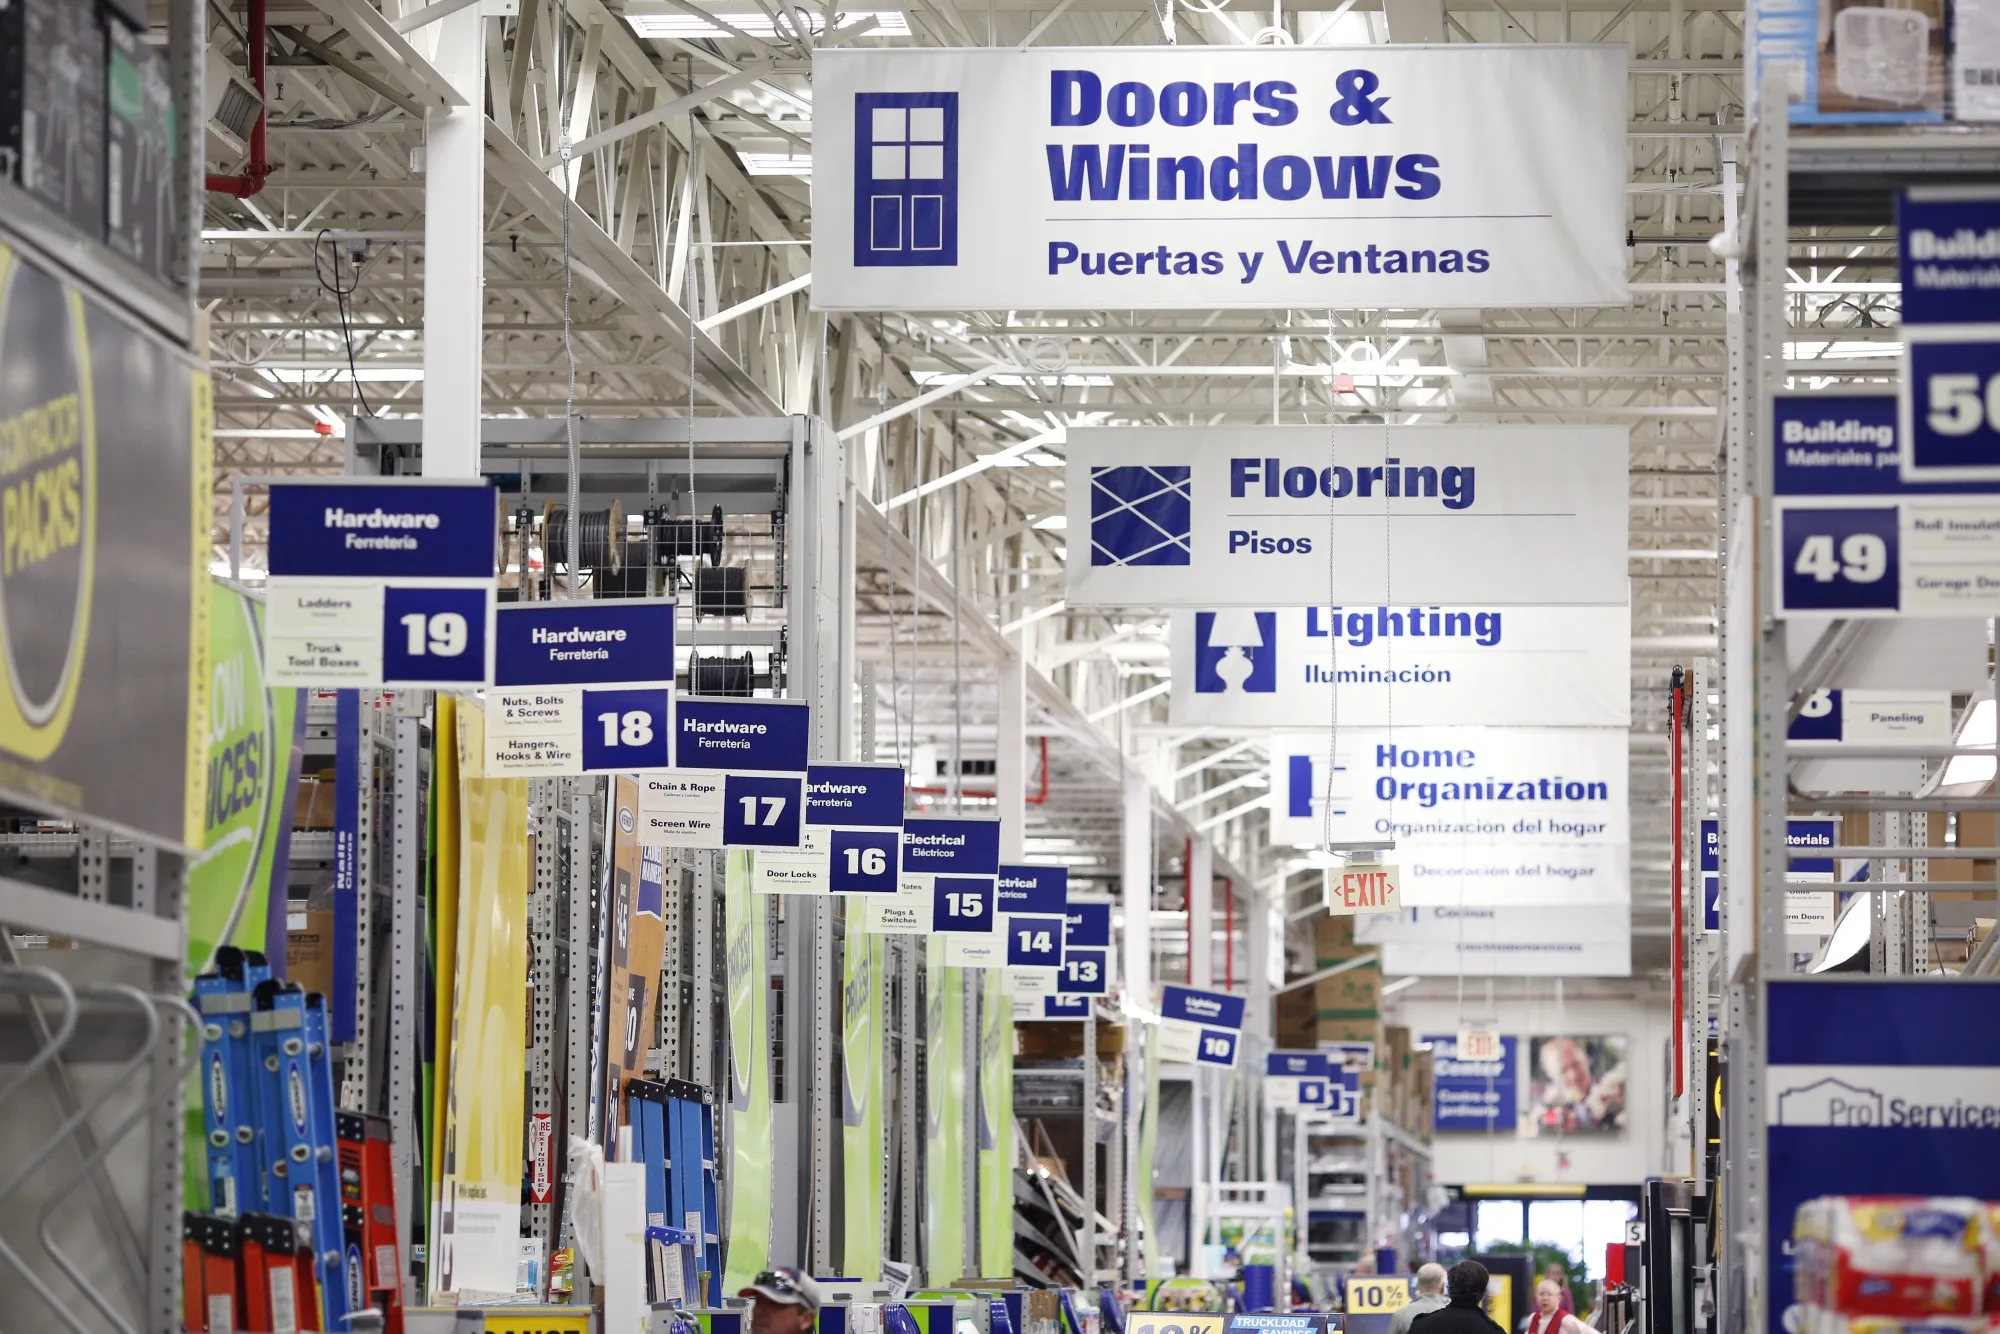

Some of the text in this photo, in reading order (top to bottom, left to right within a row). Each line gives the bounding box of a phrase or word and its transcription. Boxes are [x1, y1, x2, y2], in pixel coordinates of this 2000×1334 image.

[1050, 69, 1393, 127] Doors &
[1046, 143, 1441, 201] Windows
[1048, 240, 1490, 284] Puertas y Ventanas
[1926, 372, 2000, 436] 5
[1783, 420, 1893, 448] Building
[1786, 448, 1872, 466] Materiales
[1230, 458, 1475, 510] Flooring
[3, 456, 80, 578] PACKS
[325, 508, 440, 529] Hardware
[1229, 530, 1312, 554] Pisos
[1795, 534, 1886, 583] 49
[298, 599, 351, 608] Ladders
[400, 612, 468, 657] 19
[532, 627, 627, 644] Hardware
[1307, 607, 1502, 647] Lighting
[306, 643, 341, 653] Truck
[550, 647, 609, 661] Ferretería
[288, 657, 359, 667] Tool Boxes
[1304, 664, 1452, 684] Iluminación
[212, 651, 246, 742] OW
[502, 696, 564, 706] Nuts, Bolts
[506, 708, 560, 717] & Screws
[1870, 713, 1924, 724] Paneling
[598, 711, 653, 747] 18
[683, 718, 767, 734] Hardware
[508, 740, 559, 750] Hangers,
[698, 738, 751, 749] Ferretería
[496, 751, 571, 761] Hooks & Wire
[1376, 744, 1476, 768] Home
[649, 782, 716, 793] Chain & Rope
[807, 781, 867, 794] ardware
[1376, 776, 1608, 807] Organization
[739, 796, 786, 826] 17
[807, 797, 853, 807] Ferretería
[651, 819, 711, 829] Screen Wire
[1375, 818, 1606, 837] Organización del hogar
[904, 833, 965, 846] Electrical
[1785, 833, 1830, 845] terials
[337, 831, 346, 890] Nails
[844, 848, 887, 876] 16
[913, 848, 955, 857] Eléctricos
[766, 870, 789, 878] Door
[1414, 864, 1596, 879] Decoración del hogar
[999, 877, 1037, 889] ctrical
[1343, 873, 1388, 907] EXIT
[945, 893, 983, 918] 15
[1018, 931, 1052, 953] 14
[1066, 961, 1098, 982] 13
[1204, 1038, 1230, 1057] 10
[1829, 1097, 1873, 1126] Pro
[541, 1122, 550, 1131] RE
[1354, 1286, 1403, 1307] 10%
[1236, 1317, 1306, 1328] TRUCKLOAD
